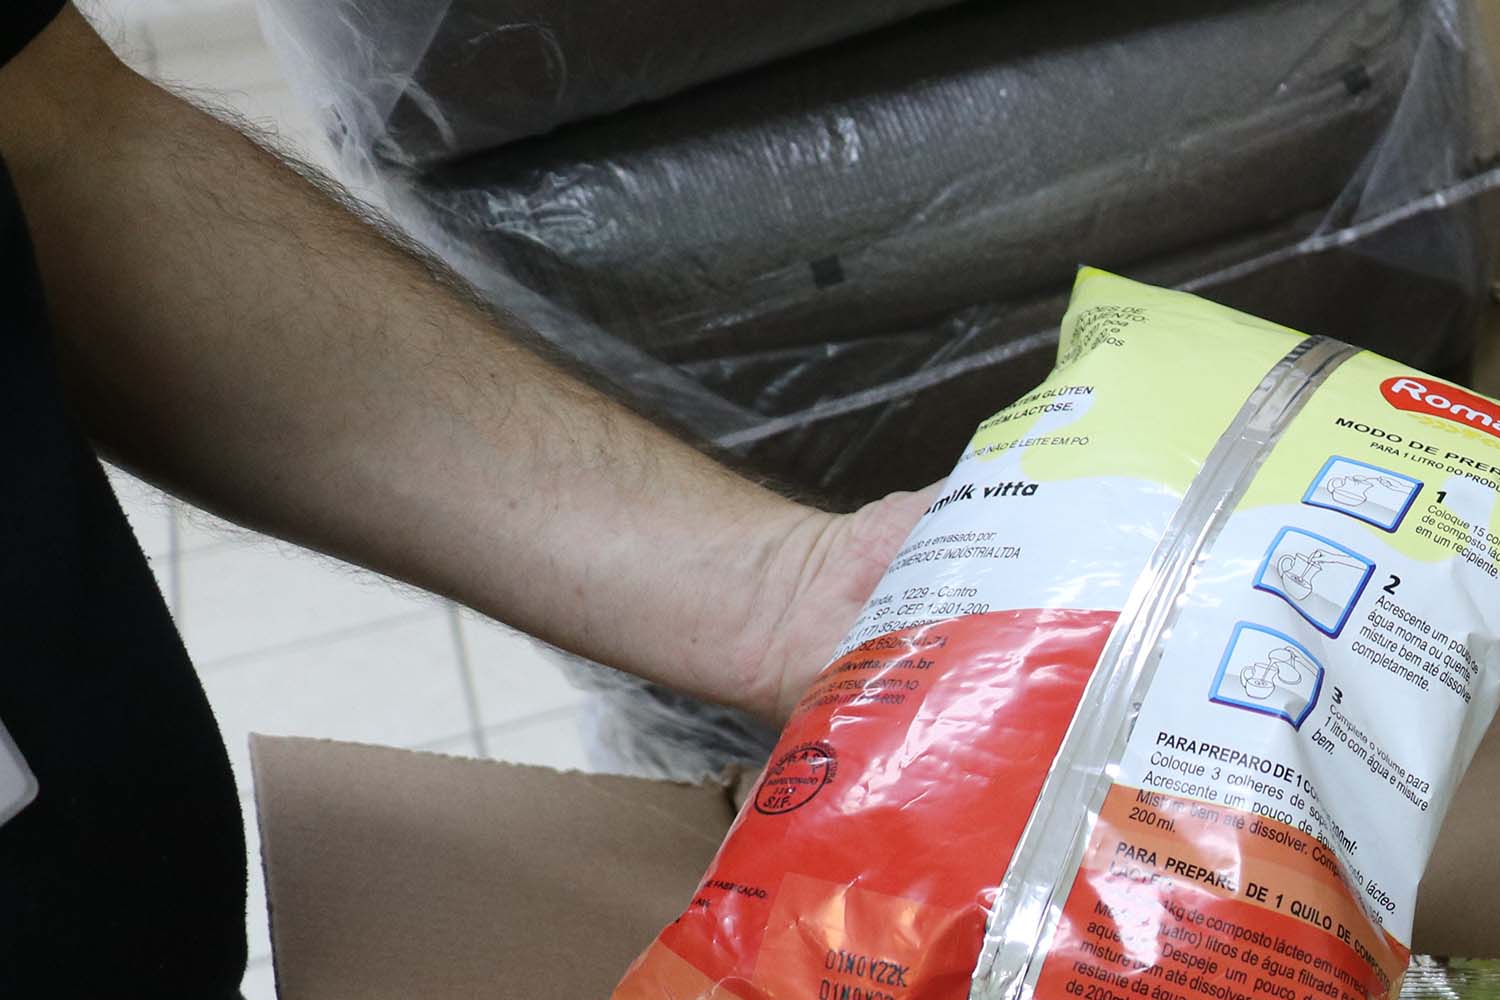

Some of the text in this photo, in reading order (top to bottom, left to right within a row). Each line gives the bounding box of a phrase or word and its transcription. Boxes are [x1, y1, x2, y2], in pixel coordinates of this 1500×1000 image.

[1042, 385, 1095, 399] GLÚTEN
[1013, 402, 1074, 421] LACTOSE.
[1019, 436, 1049, 448] LEITE
[1335, 417, 1403, 443] MODO
[1408, 440, 1440, 455] DE
[1370, 441, 1400, 455] PARA
[1410, 455, 1444, 470] LITRO
[1446, 465, 1463, 477] DO
[983, 480, 1039, 499] vitta
[1436, 490, 1447, 503] 1
[1421, 514, 1436, 526] de
[1437, 521, 1487, 552] composto
[1427, 505, 1470, 531] Coloque
[1472, 525, 1486, 537] 15
[1415, 525, 1500, 580] em um recipiente.
[901, 586, 929, 600] 1229
[1383, 574, 1401, 595] 2
[1368, 609, 1428, 651] água morna
[1375, 594, 1431, 635] Acrescente
[1351, 640, 1431, 692] completamente.
[1360, 624, 1440, 676] misture bem até
[1330, 686, 1343, 704] 3
[1157, 732, 1294, 783] PARA PREPARO DE
[1312, 729, 1336, 755] bem.
[1150, 751, 1306, 810] Coloque 3 colheres de
[1349, 739, 1429, 811] com misture
[1406, 772, 1430, 794] para
[1129, 807, 1157, 826] 200
[1143, 770, 1313, 837] Acrescente pouco de
[1250, 822, 1308, 855] dissolver.
[1116, 841, 1332, 931] PARA DE QUILO
[1162, 942, 1218, 974] Despeje
[1207, 916, 1314, 965] composto lácteo
[1205, 937, 1296, 981] litros água
